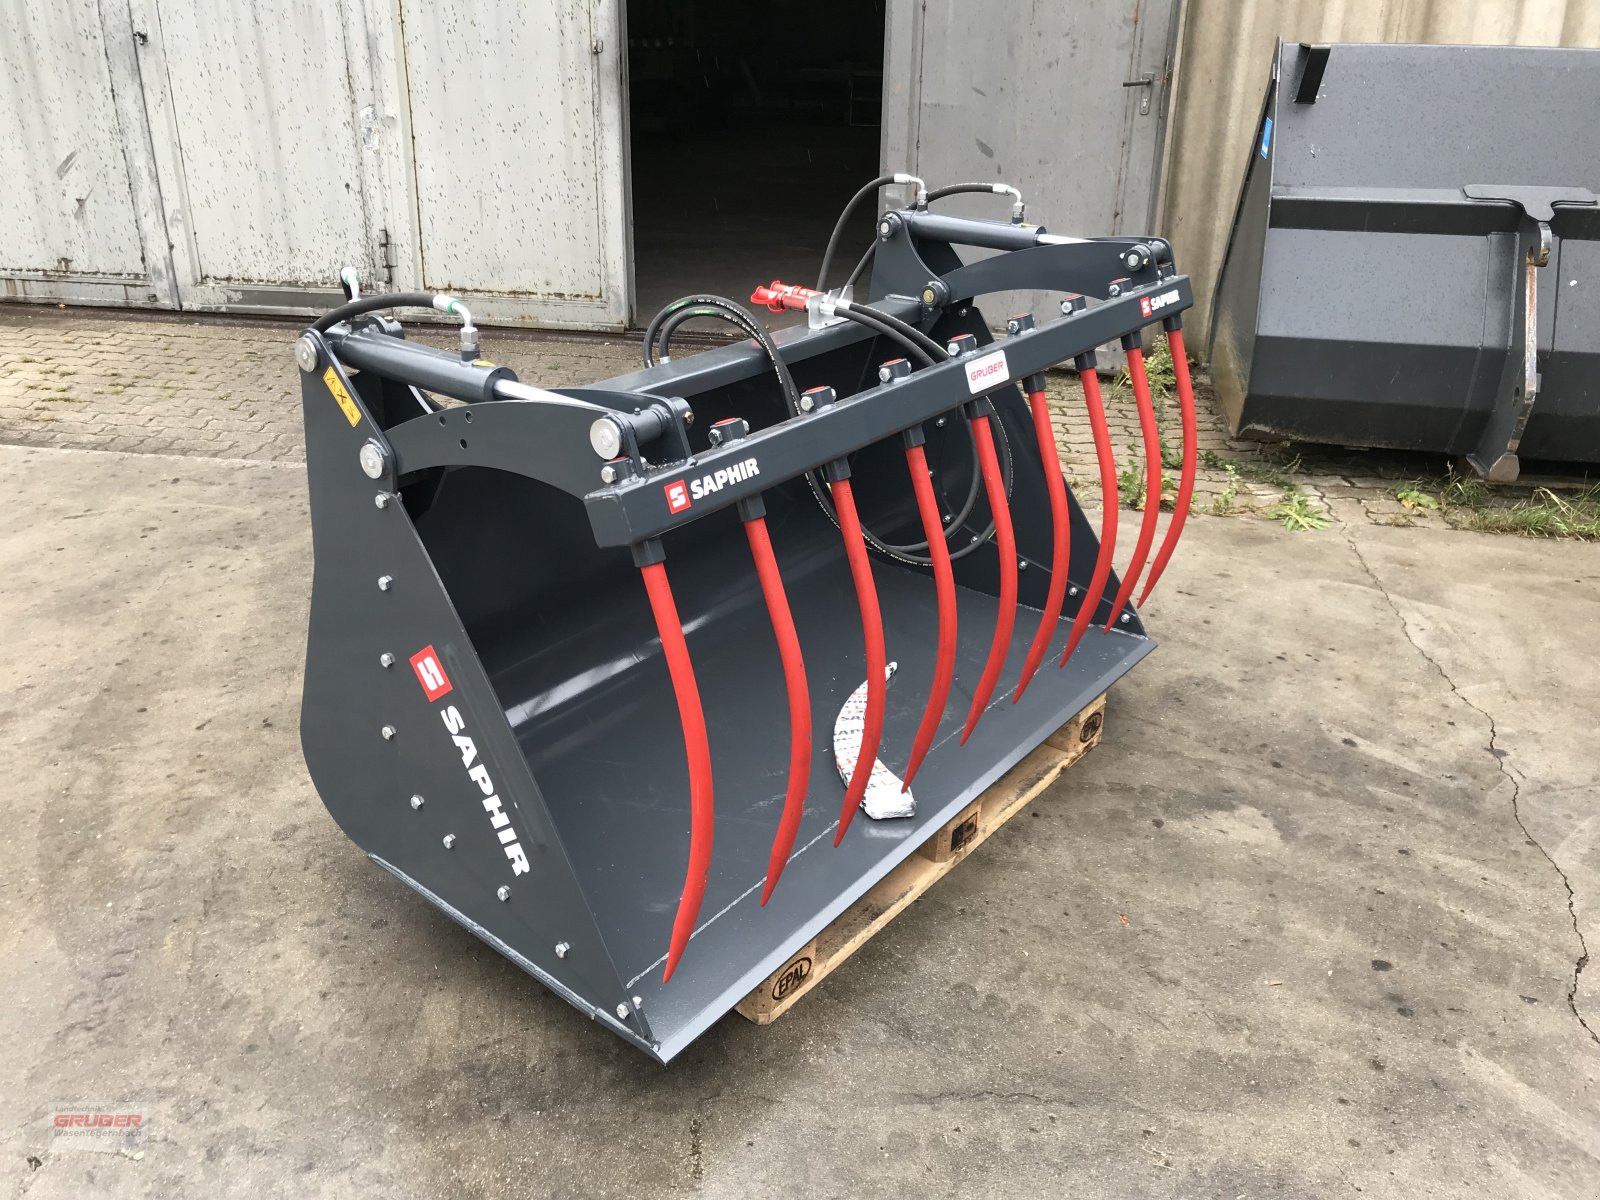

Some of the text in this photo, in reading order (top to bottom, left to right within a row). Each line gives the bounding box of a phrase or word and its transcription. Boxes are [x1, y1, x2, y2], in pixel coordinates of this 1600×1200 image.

[1150, 289, 1180, 311] SAPH
[970, 361, 1004, 381] GRUBER
[690, 457, 760, 500] SAPHIR
[440, 705, 531, 877] SAPHIR
[778, 963, 807, 996] EPAL
